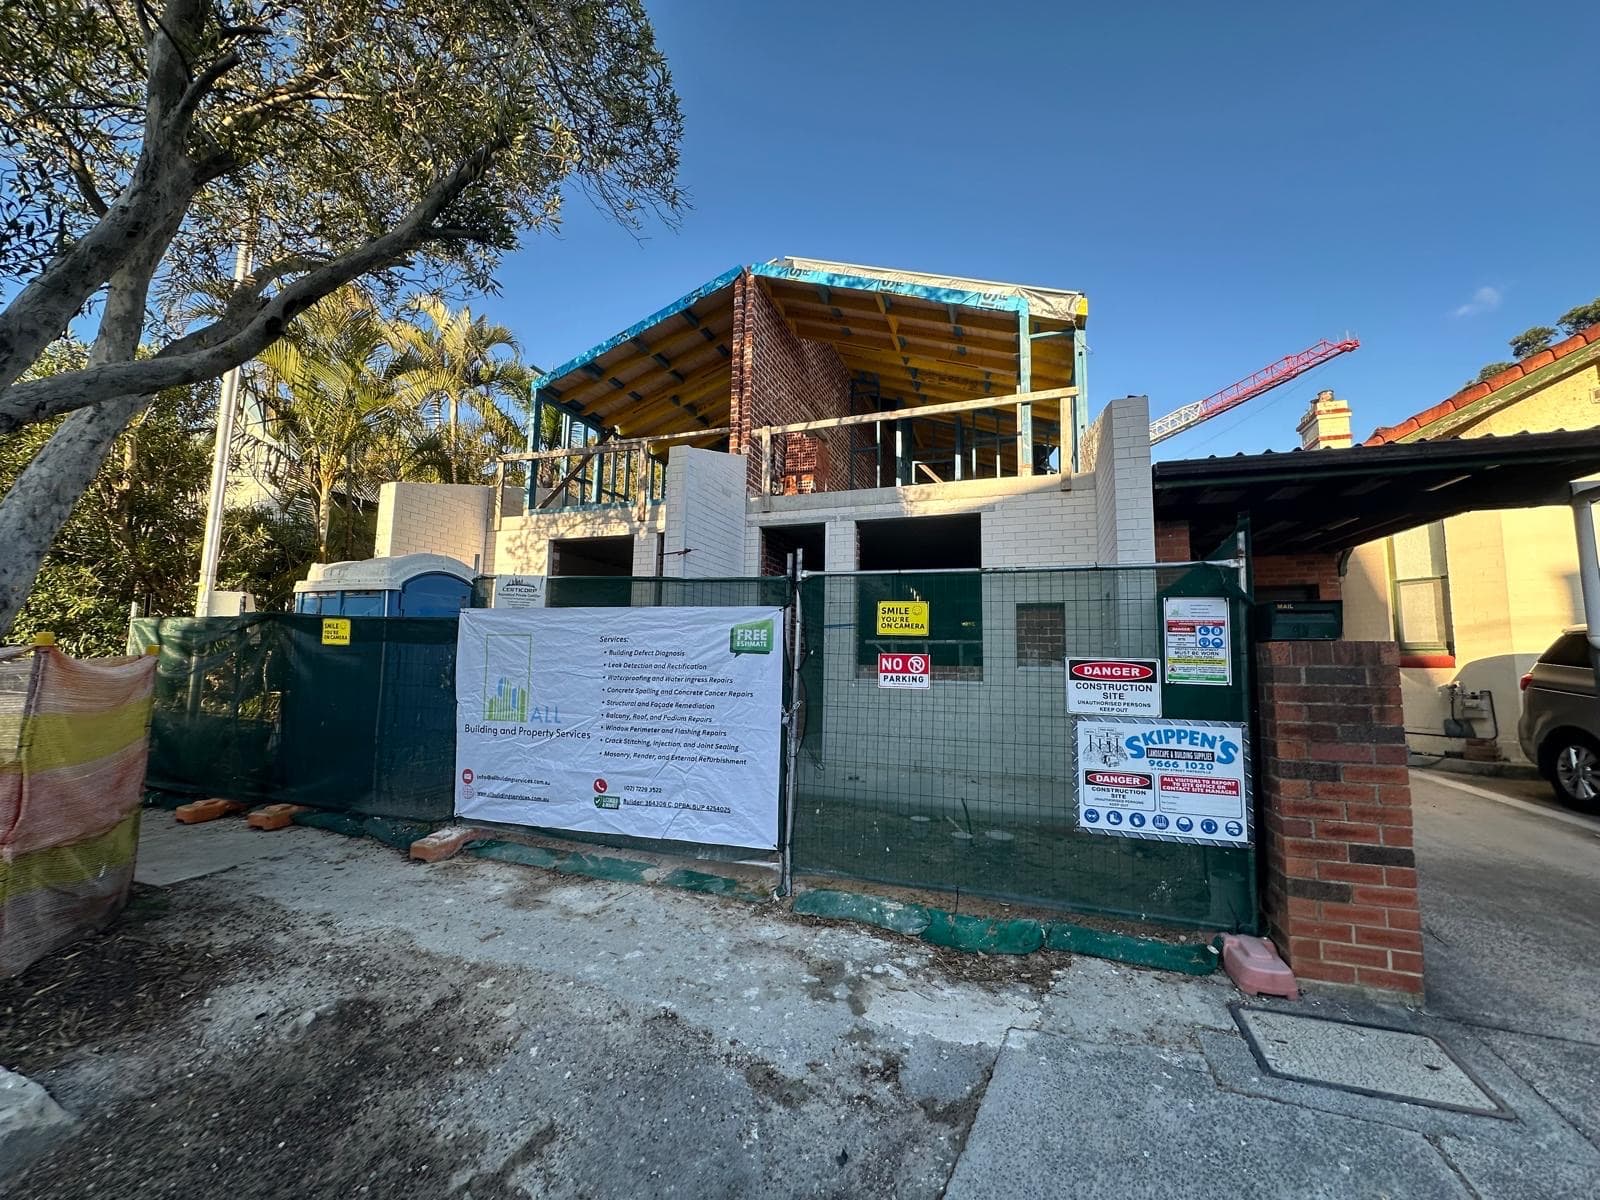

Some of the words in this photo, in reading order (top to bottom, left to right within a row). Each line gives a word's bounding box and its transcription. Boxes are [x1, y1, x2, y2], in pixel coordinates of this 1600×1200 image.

[736, 629, 768, 641] FREE
[600, 636, 629, 644] Services:
[655, 650, 685, 658] Diagnosis
[881, 658, 902, 670] NO
[1084, 666, 1140, 676] DANGER
[608, 675, 650, 683] Waterproofing
[884, 675, 924, 683] PARKING
[1076, 682, 1153, 692] CONSTRUCTION
[635, 688, 659, 696] Spalling
[1102, 692, 1125, 700] SITE
[675, 702, 715, 710] Remediation
[530, 706, 562, 724] ALL
[606, 712, 631, 720] Balcony,
[464, 724, 498, 736] Building
[500, 726, 516, 736] and
[519, 727, 554, 739] Property
[556, 728, 591, 740] Services
[675, 728, 701, 736] Flashing
[702, 729, 727, 737] Repairs
[623, 738, 652, 747] Stitching,
[715, 743, 739, 752] Sealing
[1125, 729, 1239, 764] SKIPPEN'S
[604, 751, 632, 759] Masonry,
[633, 752, 656, 760] Render,
[671, 754, 698, 762] External
[699, 756, 747, 765] Refurbishment
[1148, 749, 1169, 758] LANDSCAPE
[1174, 751, 1193, 759] BUILDING
[1193, 752, 1213, 760] SUPPLIES
[1148, 760, 1179, 768] 9666
[1186, 762, 1214, 770] 1020
[1096, 775, 1140, 784] DANGER
[1091, 786, 1146, 795] CONSTRUCTION
